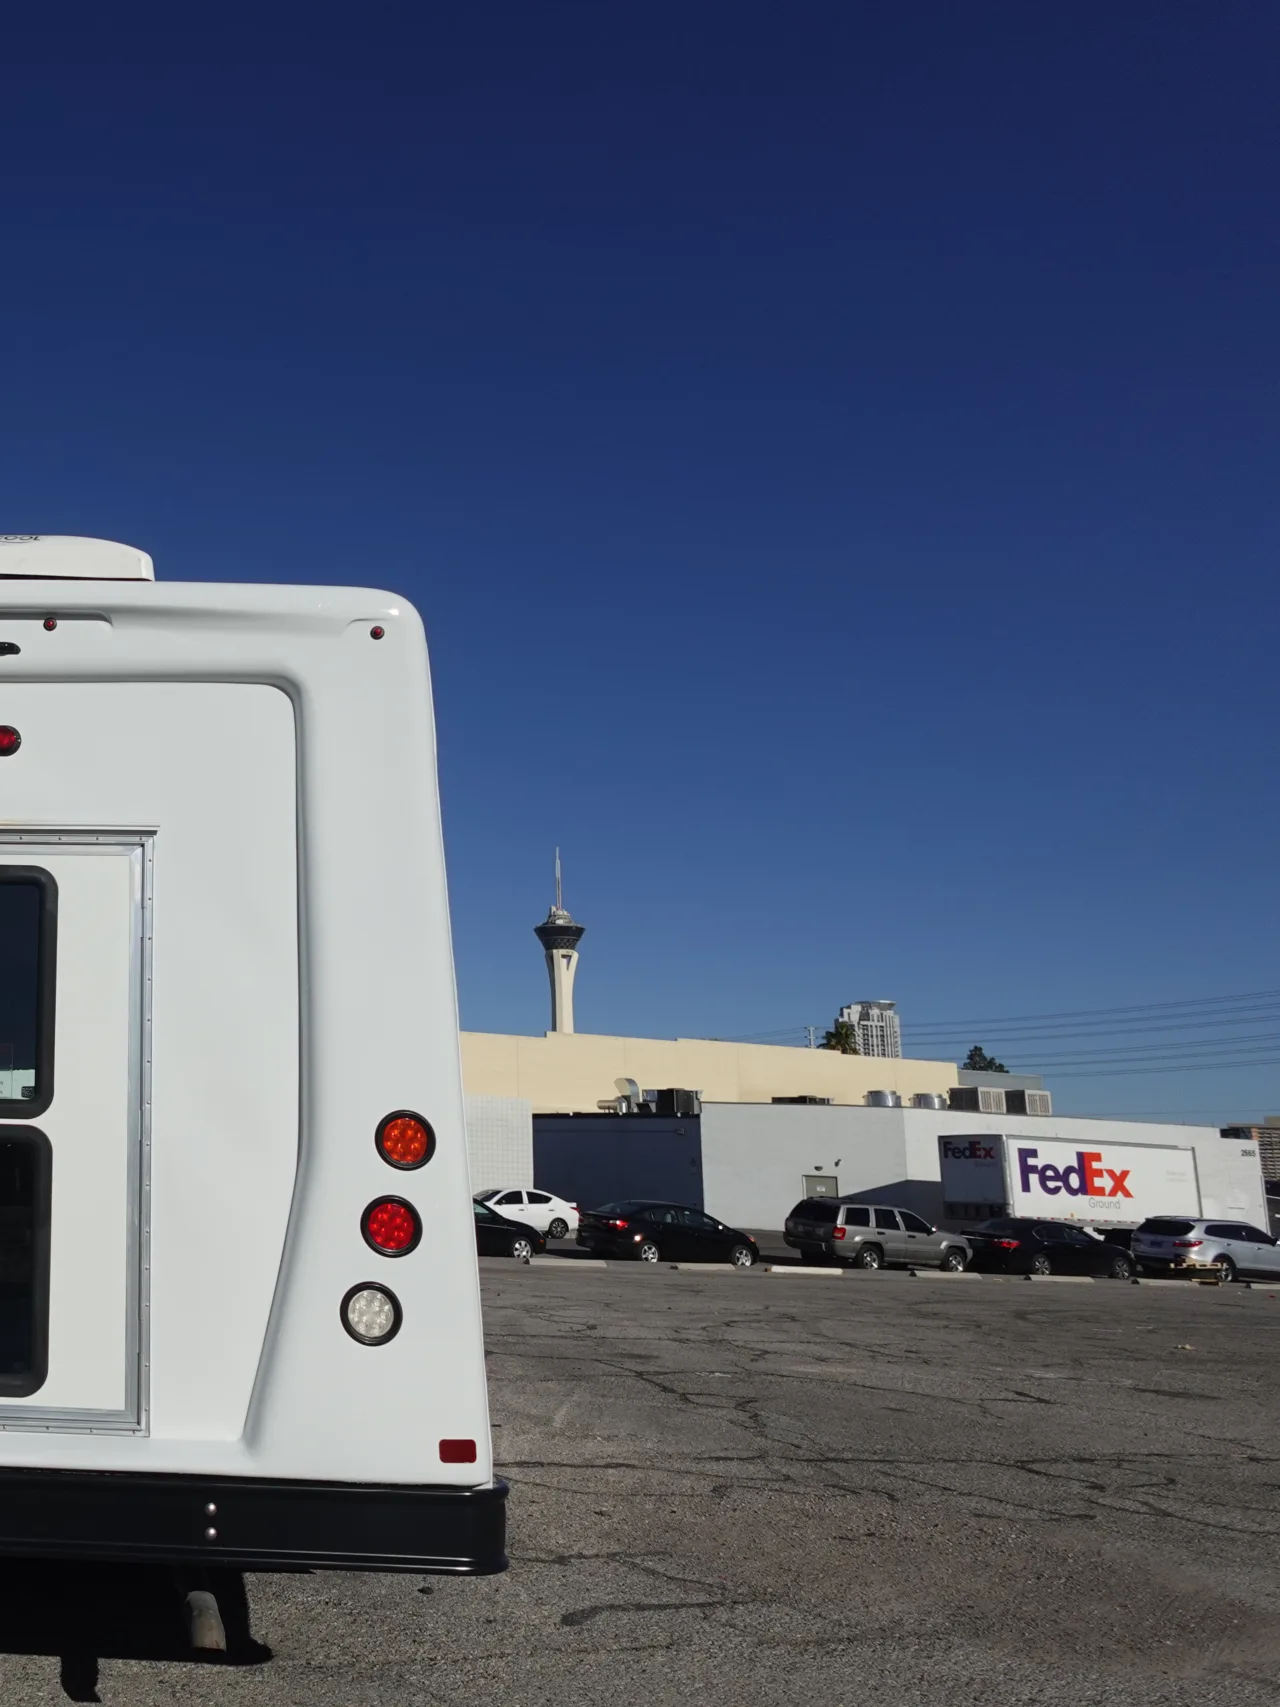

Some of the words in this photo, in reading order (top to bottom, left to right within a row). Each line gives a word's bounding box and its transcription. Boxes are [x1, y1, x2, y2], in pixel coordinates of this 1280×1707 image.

[943, 1141, 995, 1160] FedEx
[1017, 1147, 1135, 1198] FedEx
[1088, 1197, 1121, 1210] Ground
